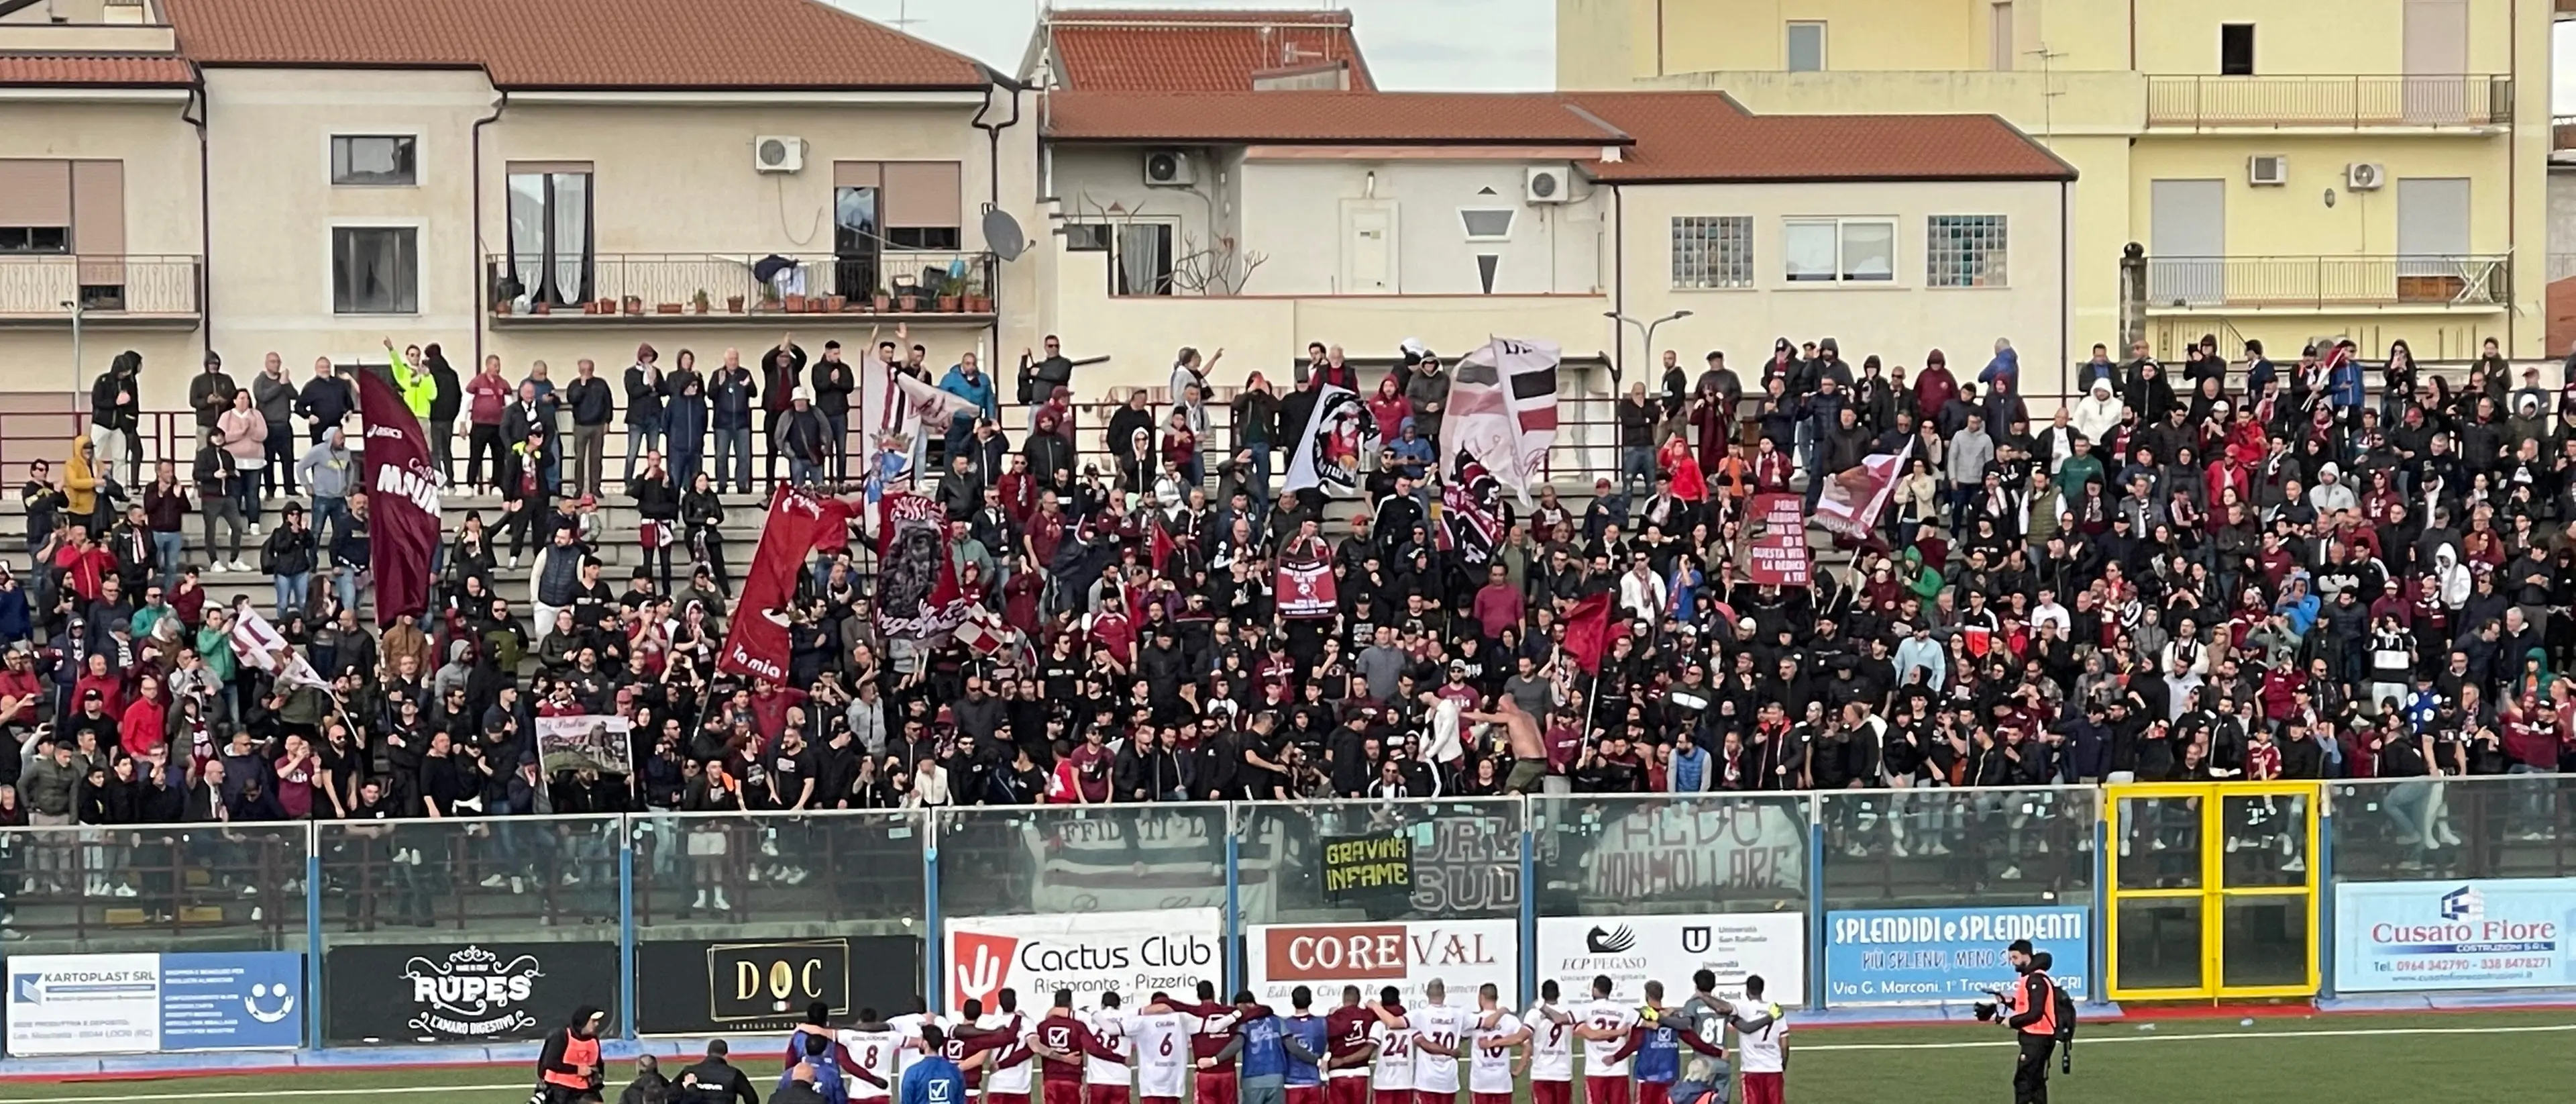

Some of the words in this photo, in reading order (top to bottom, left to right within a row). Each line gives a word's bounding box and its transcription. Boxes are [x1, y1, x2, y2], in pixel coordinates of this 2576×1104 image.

[748, 658, 781, 679] mia
[1326, 838, 1407, 865] GRAVINA
[1326, 863, 1408, 891] INFAME
[1410, 864, 1523, 911] SUD
[1835, 917, 1941, 944] SPLENDIDI
[1944, 921, 1956, 939] e
[1960, 913, 2081, 940] SPLENDENTI
[2372, 922, 2473, 944] Cusato
[2483, 919, 2557, 940] Fiore
[1021, 942, 1129, 971] Cactus
[1141, 935, 1211, 966] Club
[1560, 957, 1590, 970] ECP
[1593, 956, 1648, 970] PEGASO
[1955, 948, 1994, 968] MENO
[2397, 960, 2426, 971] 0964
[2428, 959, 2469, 970] 342790
[2480, 958, 2502, 969] 338
[44, 972, 129, 983] KARTOPLAST
[133, 971, 156, 981] SRL
[736, 958, 822, 1001] DOC
[1034, 978, 1120, 993] Ristorante
[1135, 973, 1199, 990] Pizzeria
[1833, 981, 1858, 995] Via
[1861, 980, 1876, 993] G.
[411, 975, 533, 1007] RUPES
[429, 1014, 469, 1034] L'AMARO
[470, 1013, 515, 1034] DIGESTIVO
[1548, 1022, 1562, 1047] 9
[1700, 1017, 1725, 1044] 81
[864, 1044, 879, 1069] 8
[1159, 1032, 1173, 1057] 6
[1383, 1032, 1408, 1057] 24
